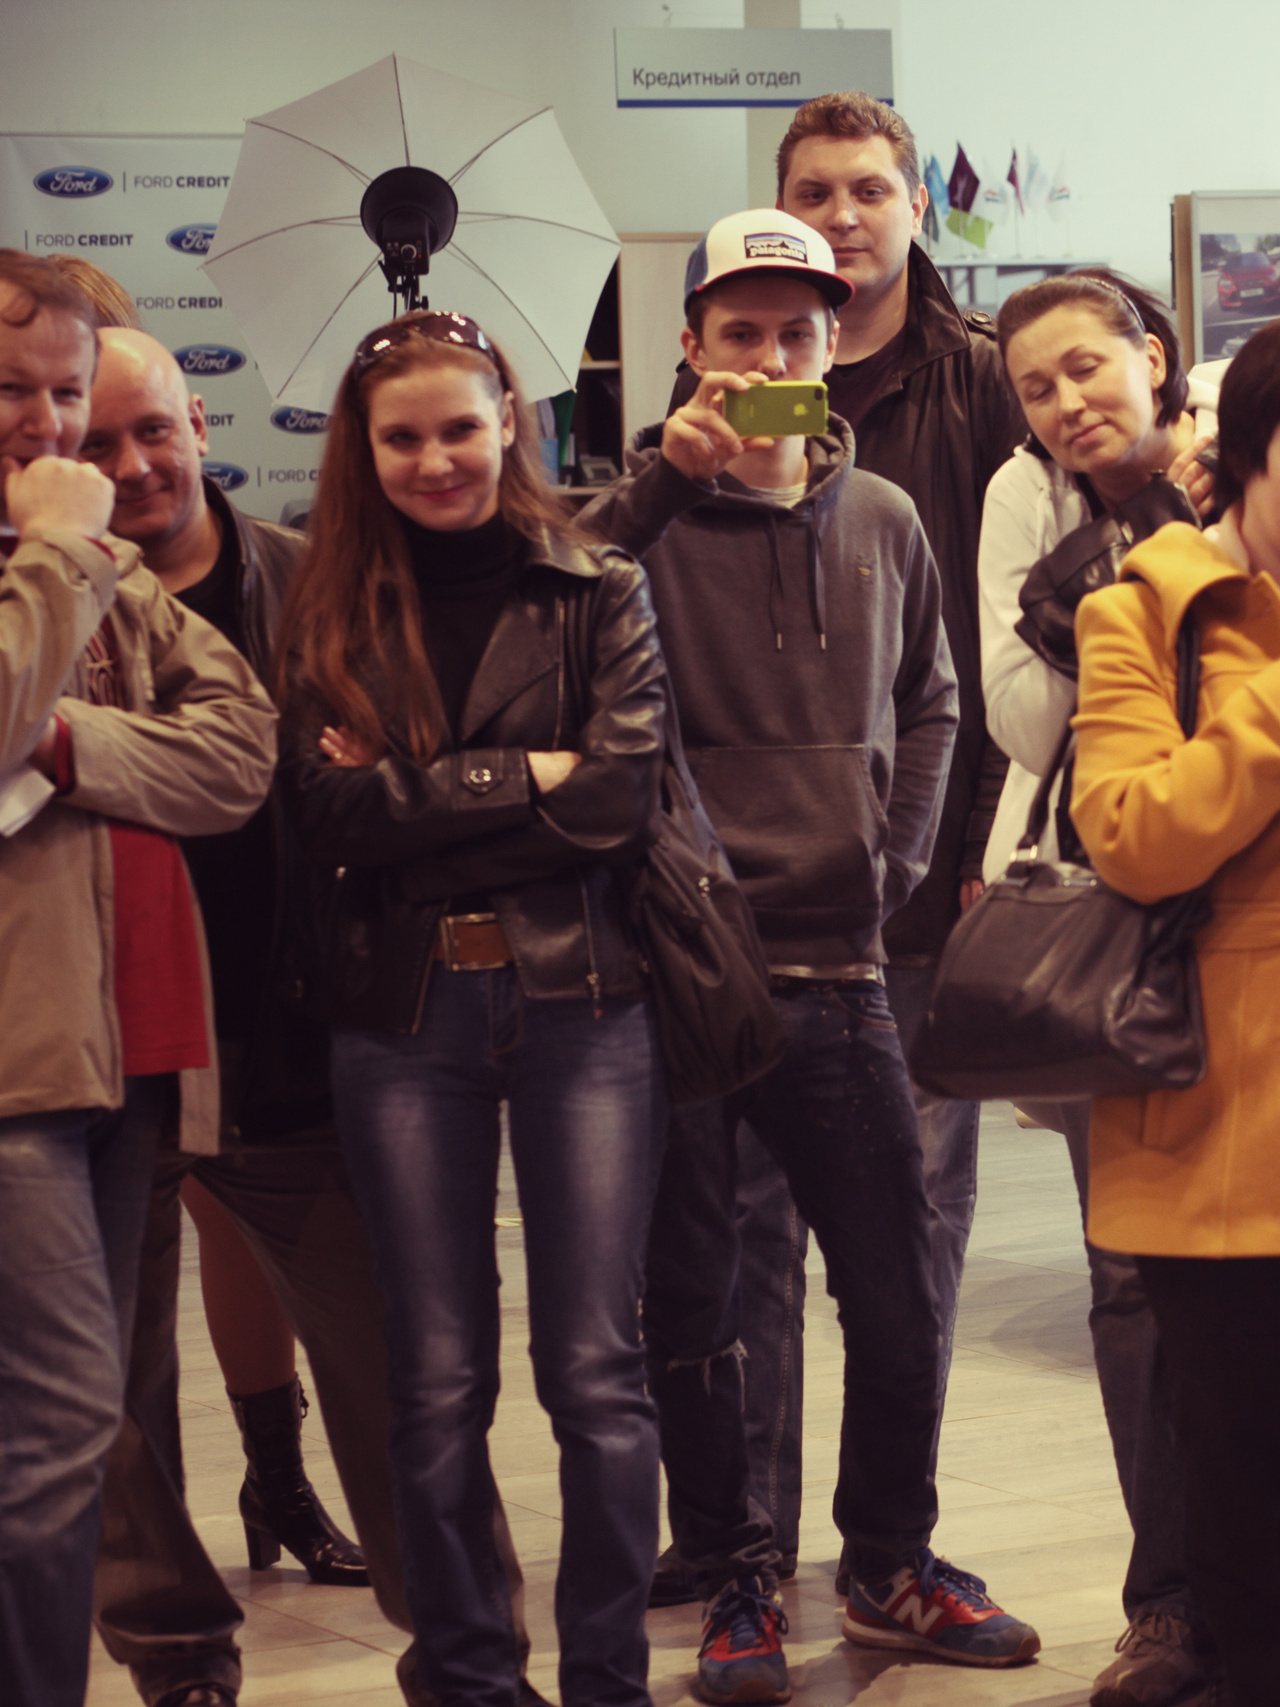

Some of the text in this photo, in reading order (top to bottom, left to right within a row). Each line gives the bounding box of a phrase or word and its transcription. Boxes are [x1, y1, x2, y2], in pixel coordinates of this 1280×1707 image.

[632, 68, 801, 89] Кредитный отдел
[50, 171, 98, 193] Ford
[134, 176, 231, 188] FORD CREDIT
[36, 234, 134, 246] FORD CREDIT
[181, 230, 214, 250] For
[136, 297, 223, 309] FORD CREDI
[184, 350, 230, 370] Ford
[268, 470, 306, 482] FORD
[893, 1594, 944, 1634] N
